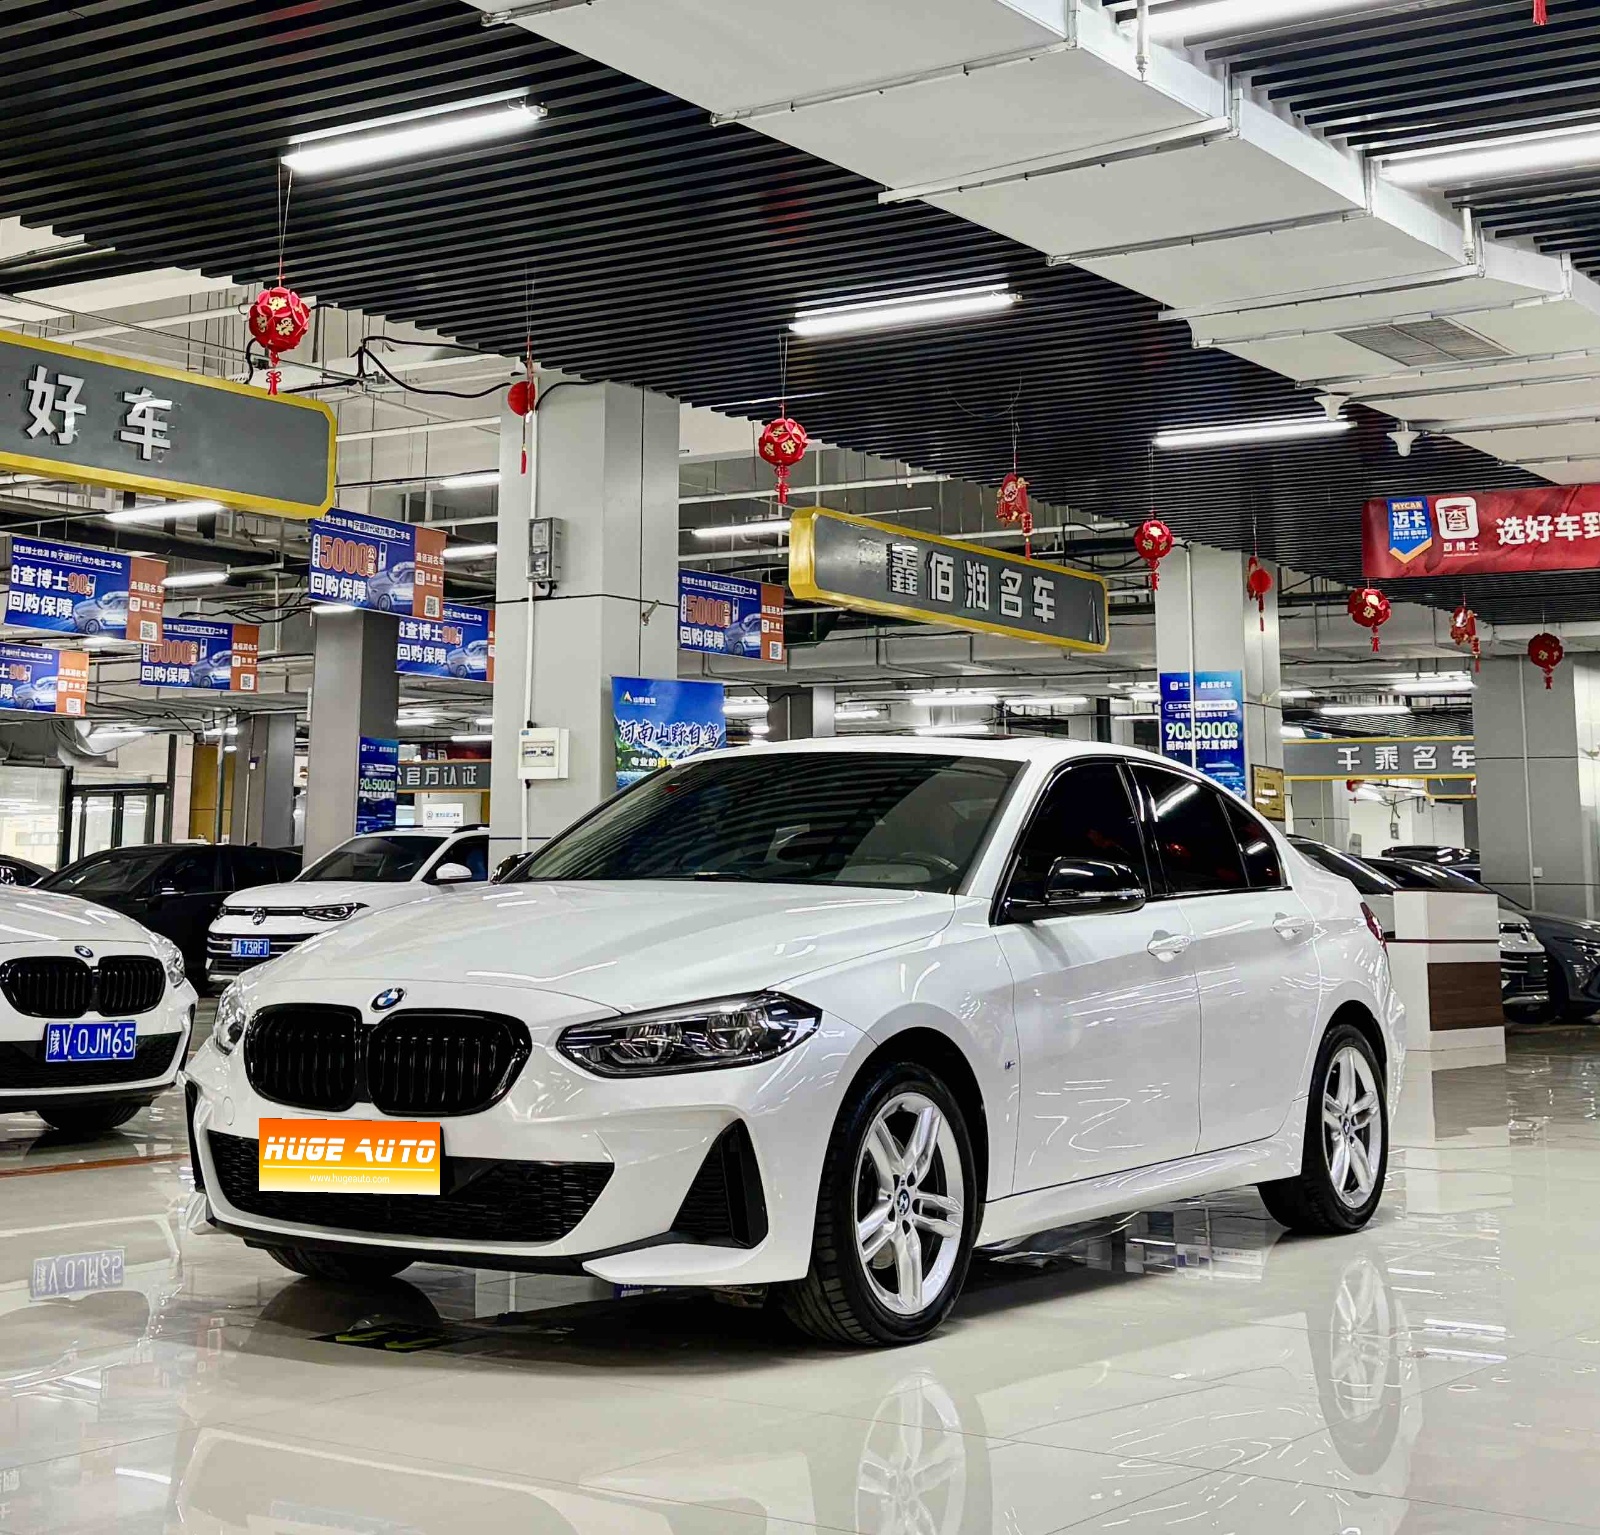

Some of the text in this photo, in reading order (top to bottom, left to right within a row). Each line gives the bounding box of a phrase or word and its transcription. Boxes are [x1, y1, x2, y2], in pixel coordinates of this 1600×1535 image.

[26, 364, 173, 460] 好车
[1392, 502, 1422, 510] MYCAR
[1393, 510, 1425, 528] 迈卡
[1496, 512, 1600, 546] 选好车到
[310, 572, 368, 603] 回购保障
[891, 543, 1056, 623] 鑫佰润名车
[8, 591, 74, 620] 回购保障
[680, 626, 725, 650] 回购保障
[396, 643, 448, 665] 回购保障
[141, 666, 191, 684] 回购保障
[619, 719, 721, 750] 河南山野自驾
[1337, 745, 1476, 771] 千乘名车
[397, 766, 477, 786] 官方认证
